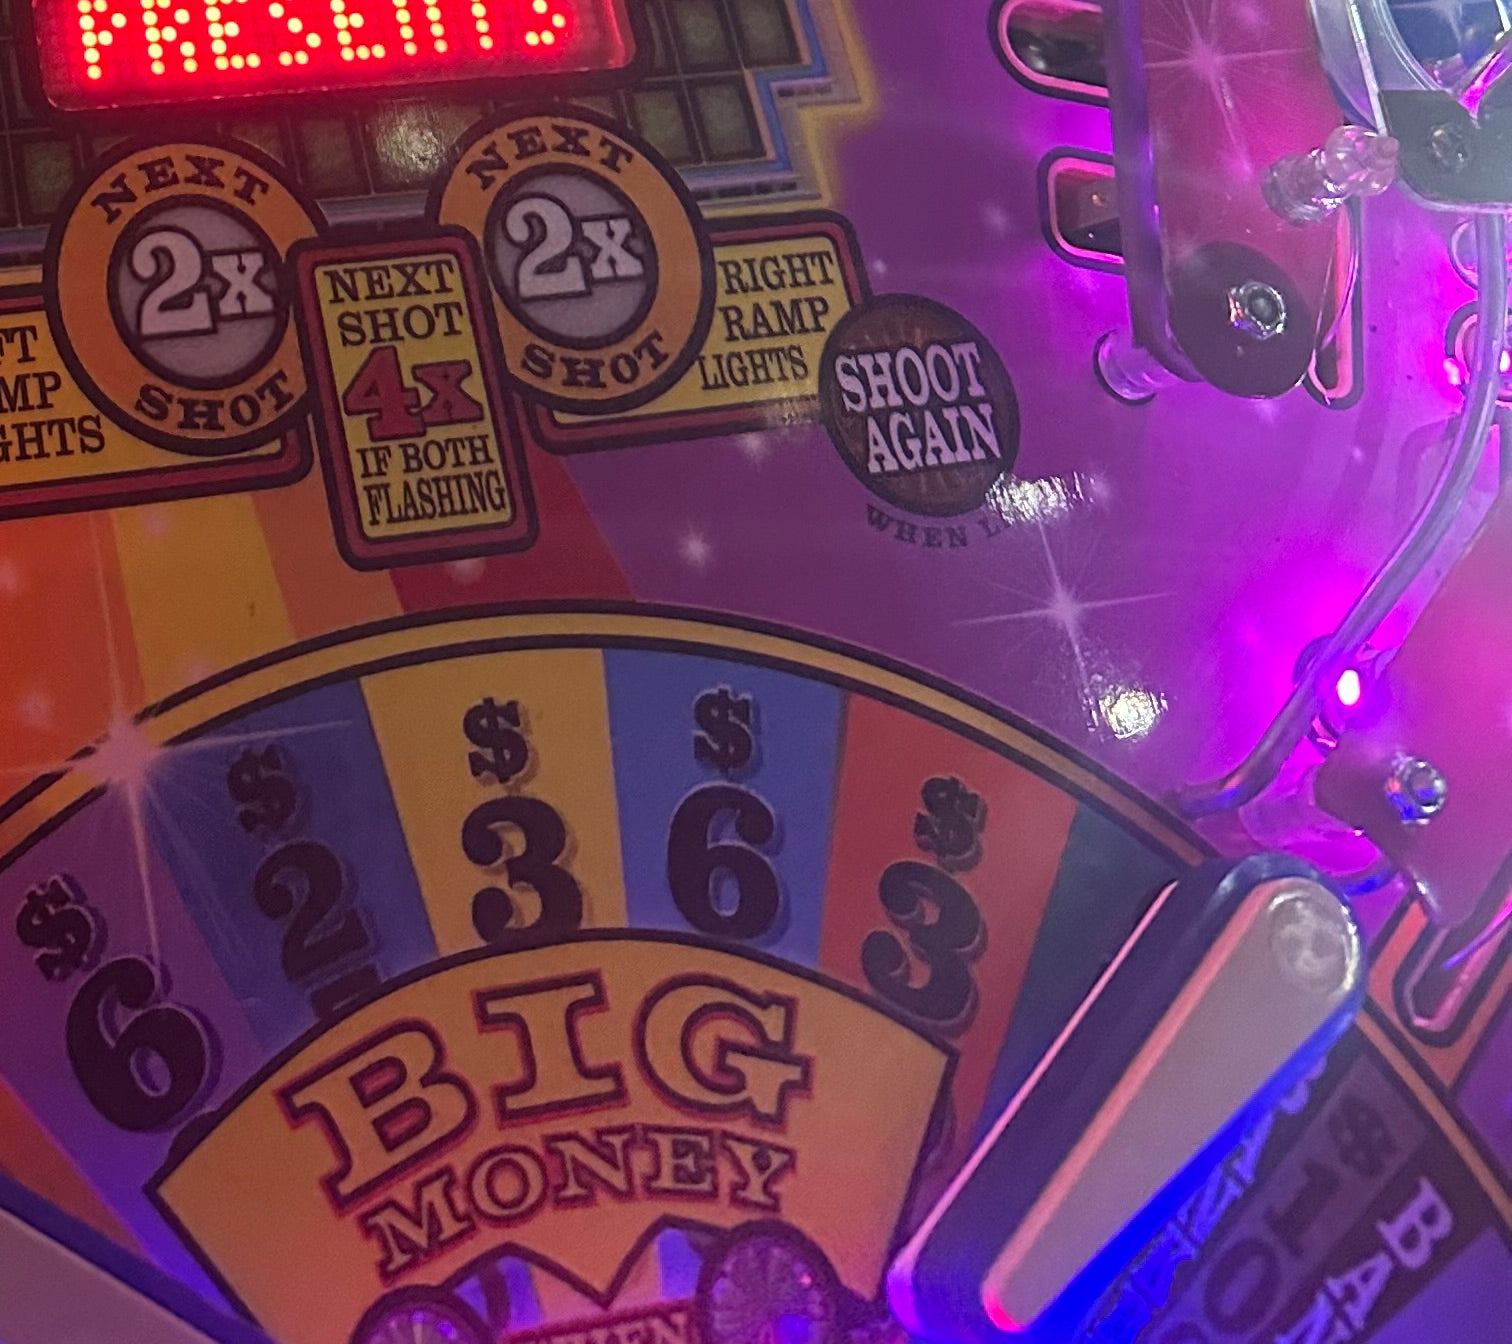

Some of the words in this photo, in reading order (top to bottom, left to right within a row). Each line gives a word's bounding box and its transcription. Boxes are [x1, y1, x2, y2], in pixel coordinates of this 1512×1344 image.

[464, 123, 634, 193] NEXT
[91, 153, 273, 224] NEXT
[323, 259, 455, 305] NEXT
[718, 250, 835, 294] RIGHT
[337, 303, 464, 349] SHOT
[719, 295, 831, 343] RAMP
[521, 327, 669, 391] SHOT
[694, 344, 810, 391] LIGHTS
[833, 341, 986, 414] SHOOT
[133, 366, 296, 432] SHOT
[355, 446, 396, 479] IF
[401, 434, 494, 476] BOTH
[866, 403, 1002, 476] AGAIN
[364, 471, 508, 527] FLASHING
[864, 503, 971, 549] WHEN
[276, 970, 813, 1214] BIG
[364, 1124, 799, 1284] MONEY
